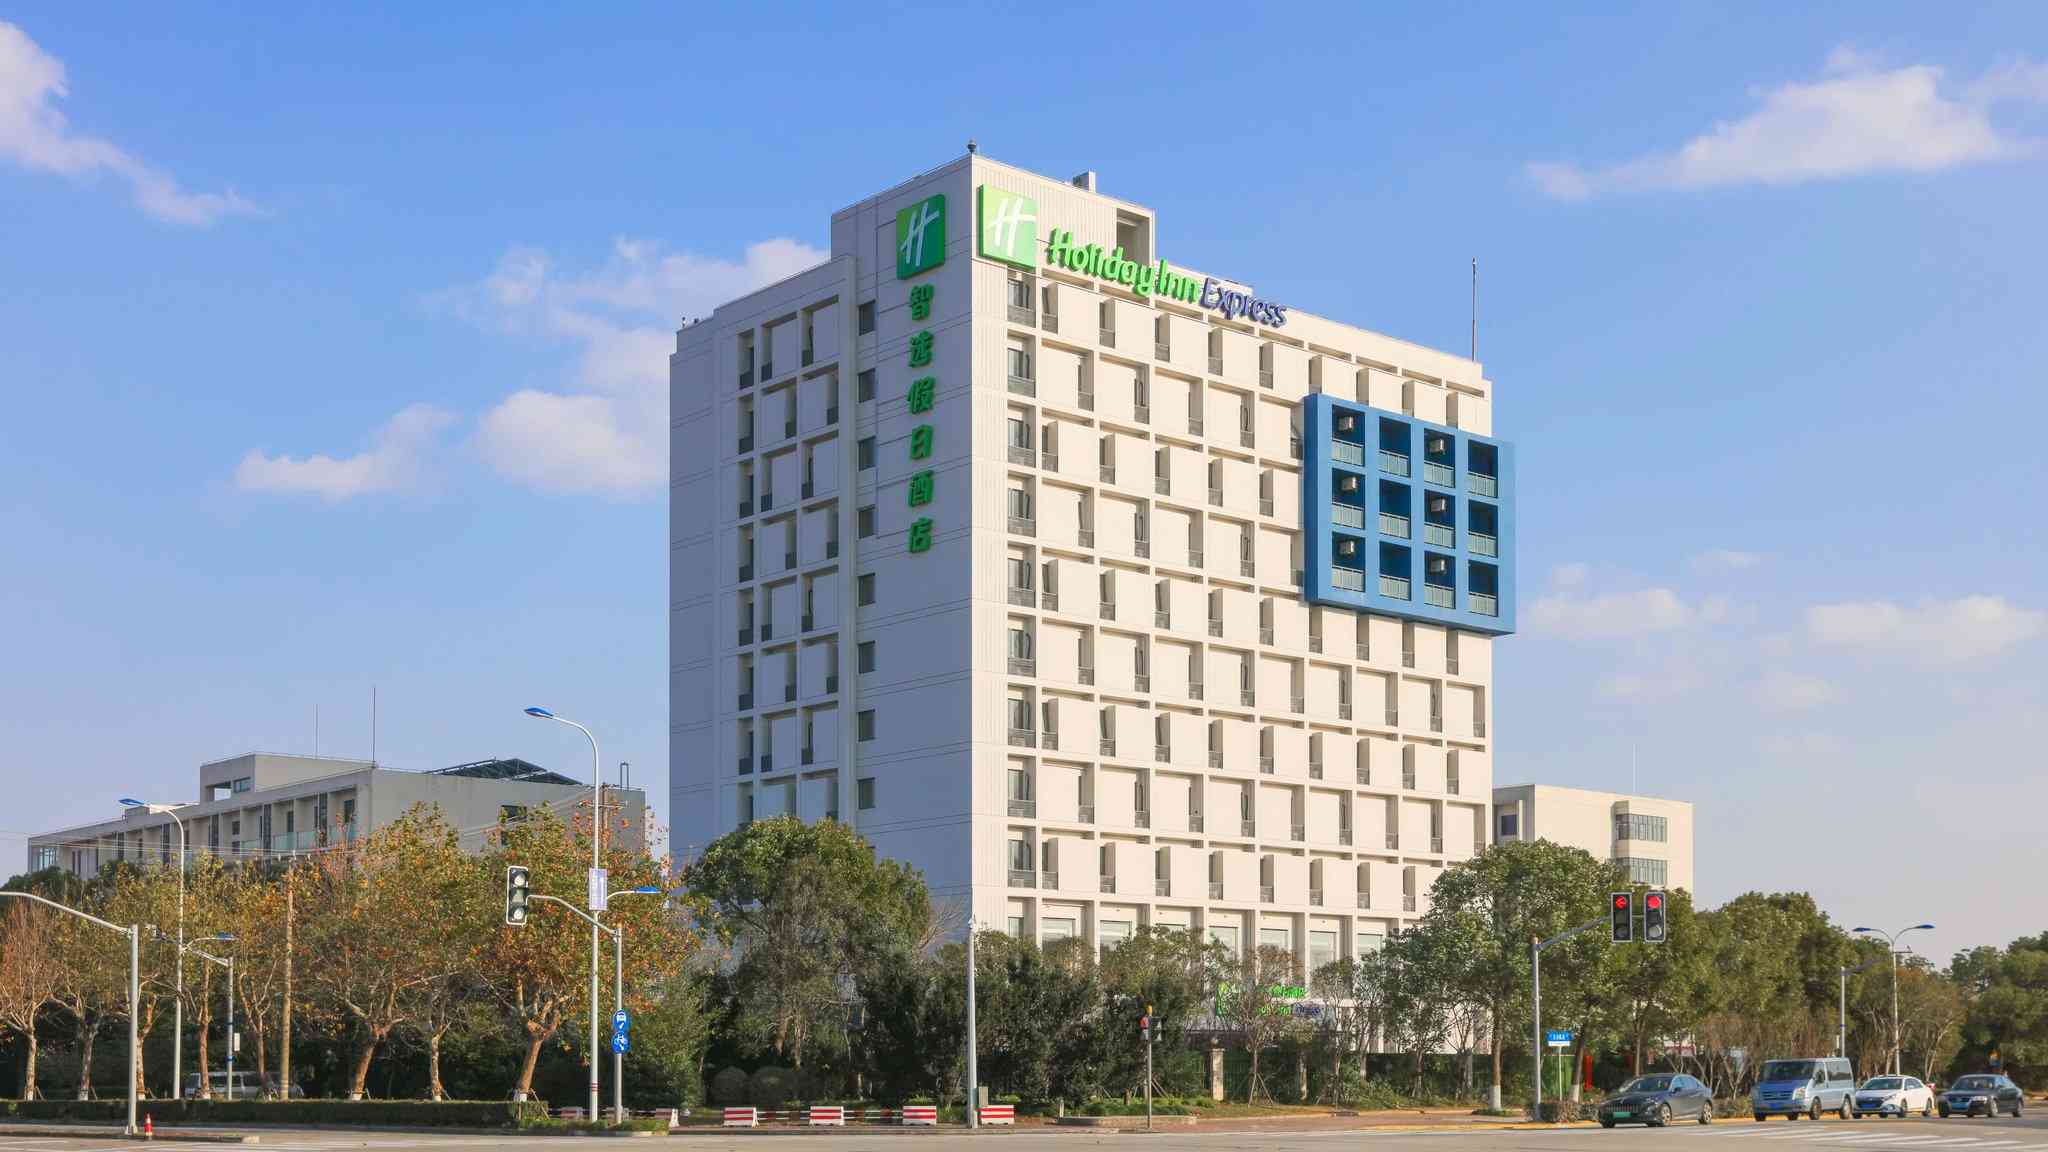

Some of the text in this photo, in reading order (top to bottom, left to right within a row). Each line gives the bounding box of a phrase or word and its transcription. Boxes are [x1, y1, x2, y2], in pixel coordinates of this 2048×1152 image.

[1047, 225, 1289, 328] Holiday Inn Express
